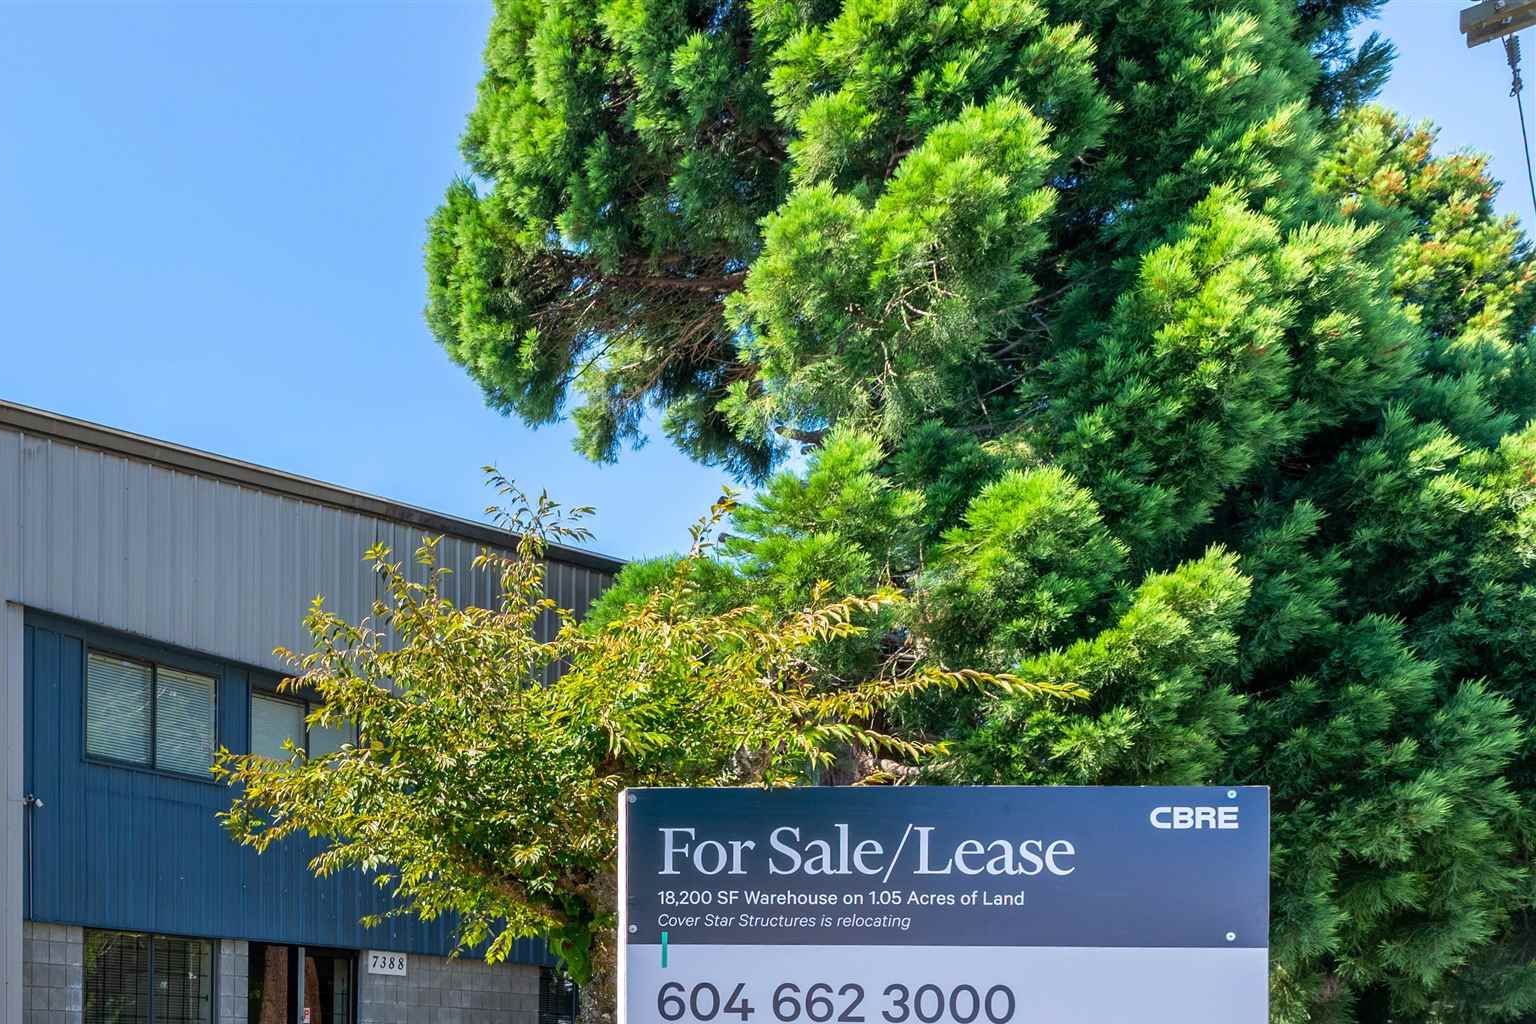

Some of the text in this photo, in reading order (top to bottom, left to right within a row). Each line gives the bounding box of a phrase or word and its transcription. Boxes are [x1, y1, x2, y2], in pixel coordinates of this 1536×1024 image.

[1149, 805, 1240, 830] CBRE
[657, 823, 1076, 884] For Sale/Lease
[657, 889, 1025, 907] 18,200 SF Warehouse on 1.05 Acres of Land
[657, 913, 912, 931] Cover Star Structures is relocating
[372, 955, 405, 970] 7388
[656, 981, 1016, 1024] 604 662 3000
